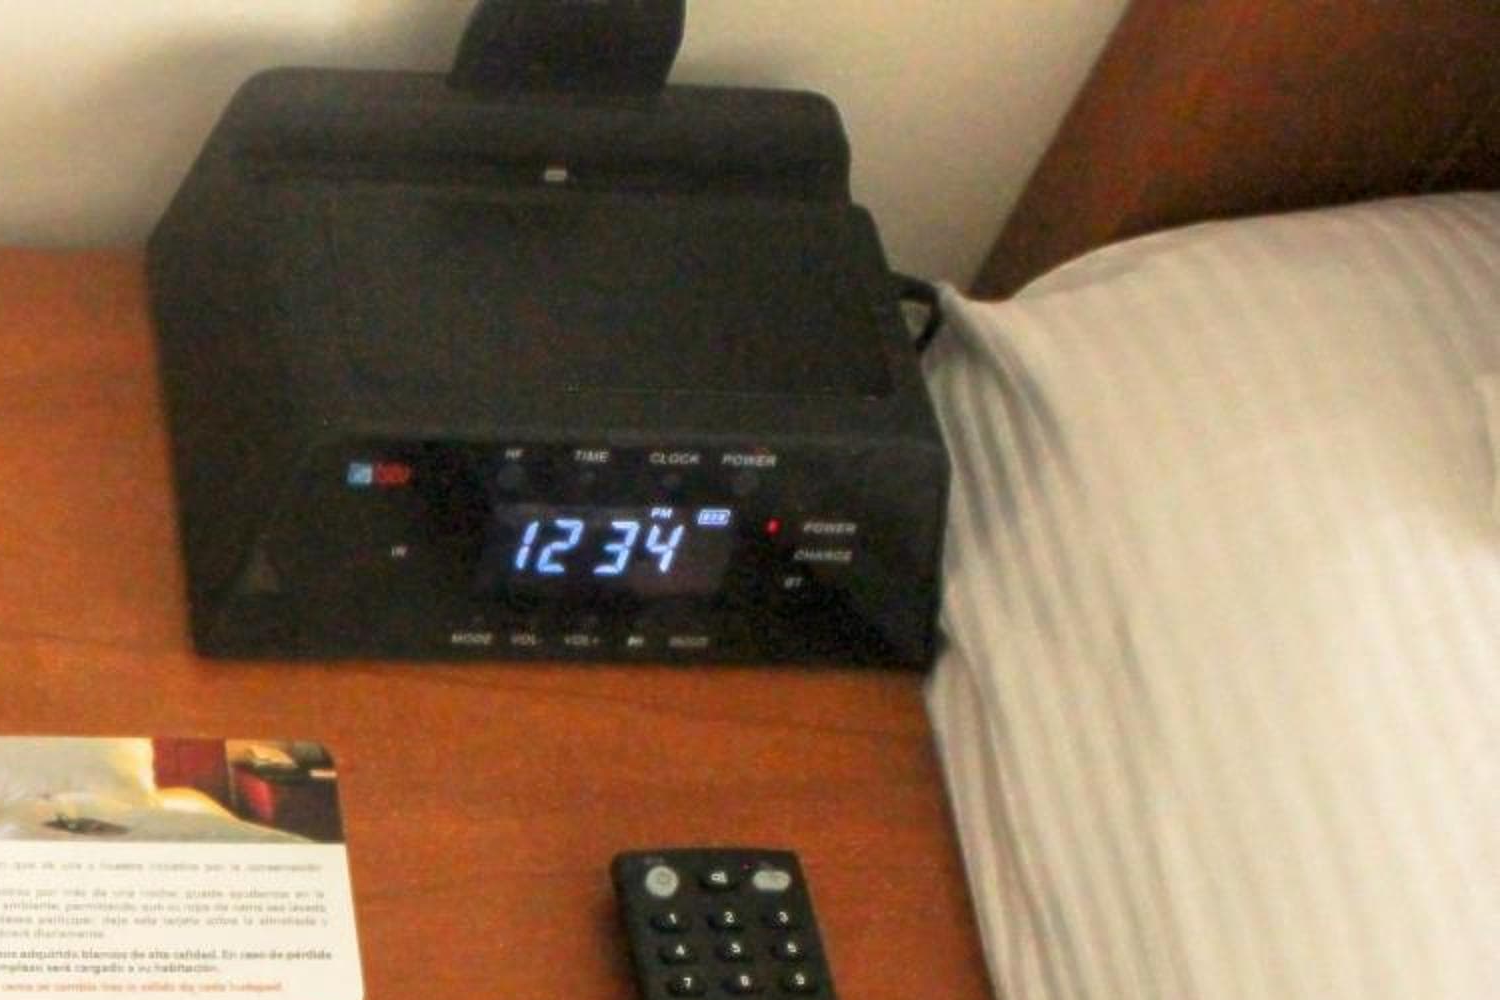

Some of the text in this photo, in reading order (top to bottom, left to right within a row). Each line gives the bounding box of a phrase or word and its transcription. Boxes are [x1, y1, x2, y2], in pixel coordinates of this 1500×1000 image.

[574, 450, 610, 463] TIME
[649, 453, 700, 465] CLOCK
[722, 454, 777, 466] POWER
[651, 507, 673, 519] PM
[803, 523, 857, 534] POWER
